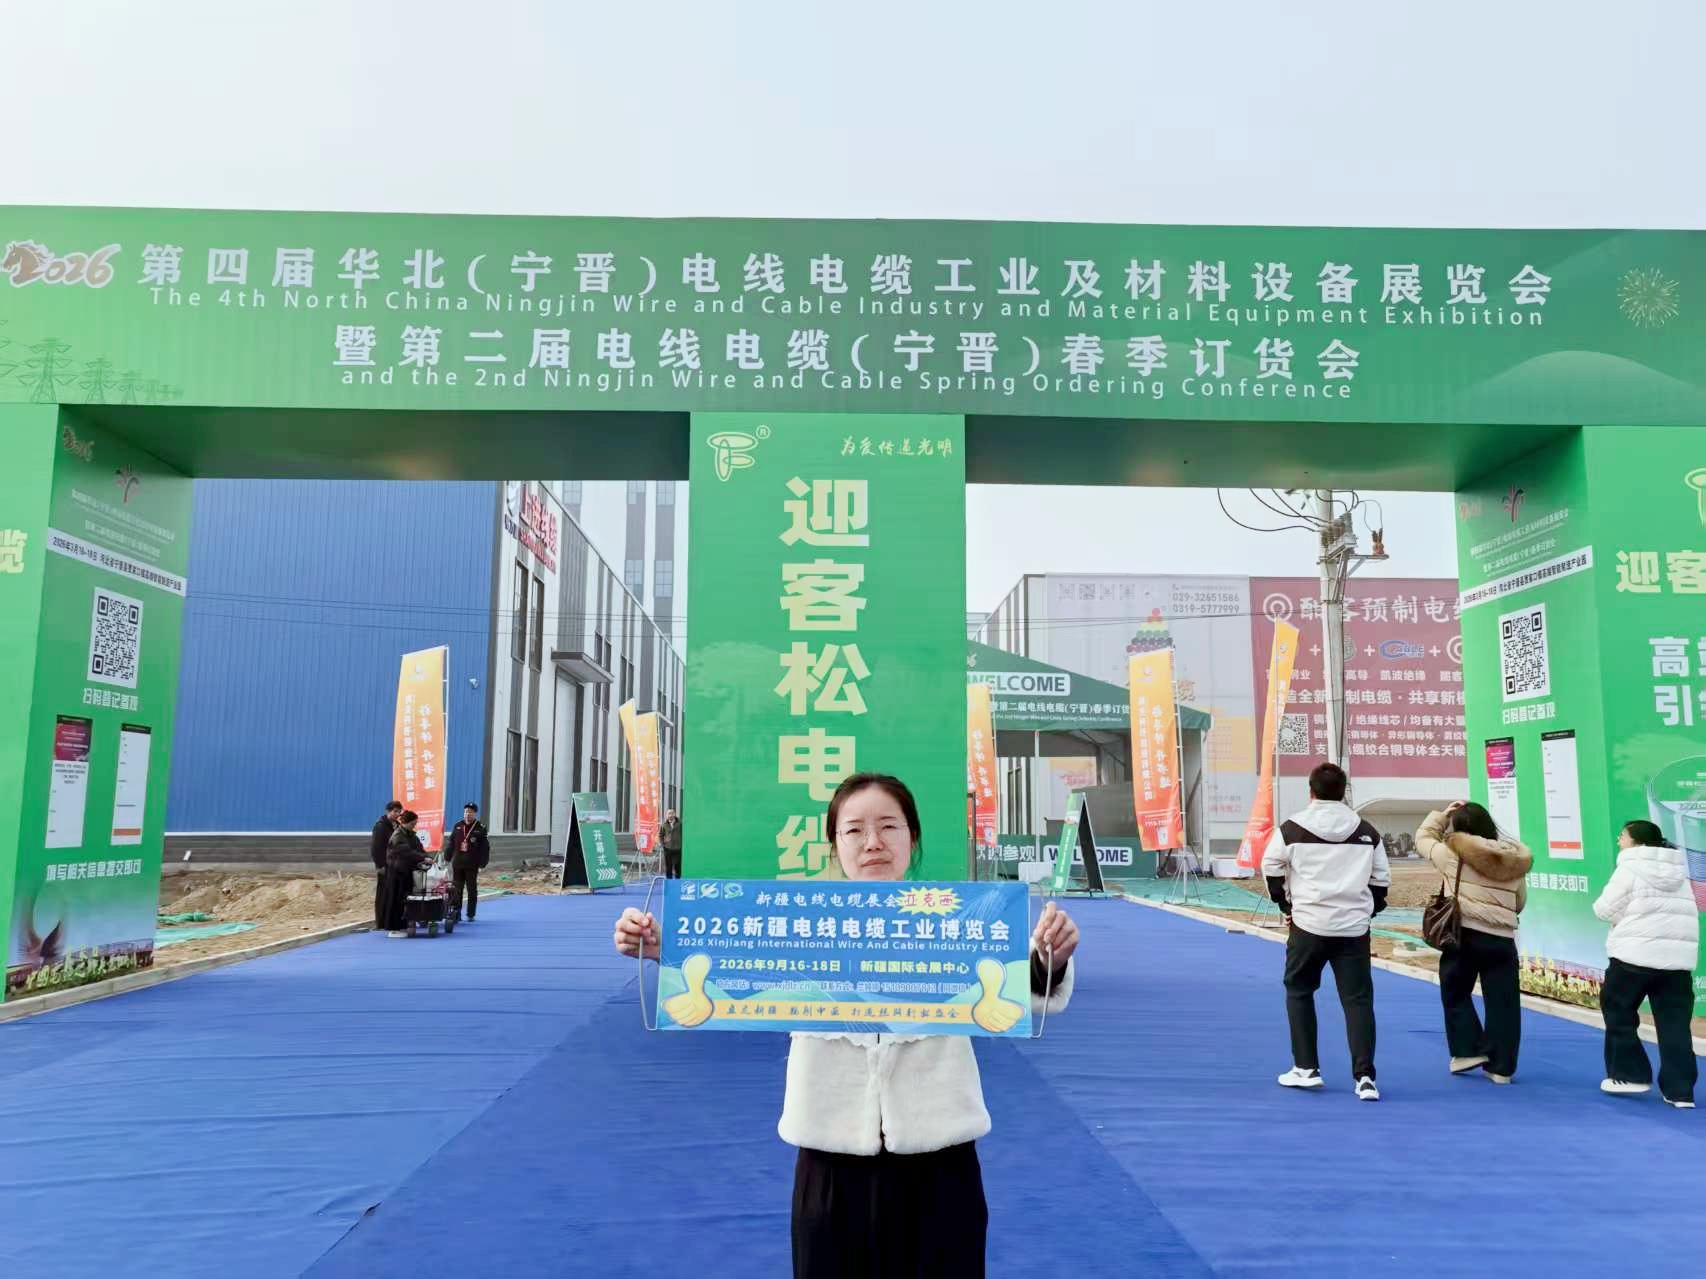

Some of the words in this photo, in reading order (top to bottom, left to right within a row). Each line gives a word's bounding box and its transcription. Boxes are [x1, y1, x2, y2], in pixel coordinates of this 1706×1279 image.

[150, 287, 201, 306] The
[218, 288, 266, 307] 4th
[284, 289, 368, 309] North
[386, 291, 468, 311] China
[486, 293, 595, 316] Ningjin
[613, 296, 677, 313] Wire
[694, 296, 744, 314] and
[762, 296, 842, 315] Cable
[859, 297, 985, 320] Industry
[1001, 299, 1050, 317] and
[1068, 300, 1191, 321] Material
[1209, 304, 1368, 326] Equipment
[1386, 306, 1543, 326] Exhibition
[341, 367, 393, 385] and
[412, 366, 457, 385] the
[475, 369, 526, 387] 2nd
[544, 369, 655, 392] Ningjin
[672, 371, 737, 388] Wire
[753, 371, 804, 389] and
[821, 371, 903, 390] Cable
[920, 373, 1015, 395] Spring
[1033, 374, 1165, 398] Ordering
[1182, 378, 1353, 398] Conference
[1648, 636, 1706, 677] 高
[1653, 684, 1706, 727] 引
[677, 915, 1010, 942] 2026新疆电线电缆工业博览会
[677, 938, 704, 947] 2026
[708, 938, 755, 949] Xinjiang
[757, 939, 834, 949] International
[837, 940, 863, 950] Wire
[867, 941, 889, 950] And
[892, 941, 925, 950] Cable
[929, 941, 978, 953] Industry
[981, 943, 1010, 953] Expo
[719, 958, 841, 973] 2026年9月16-18日
[860, 959, 971, 975] 新疆国际会展中心
